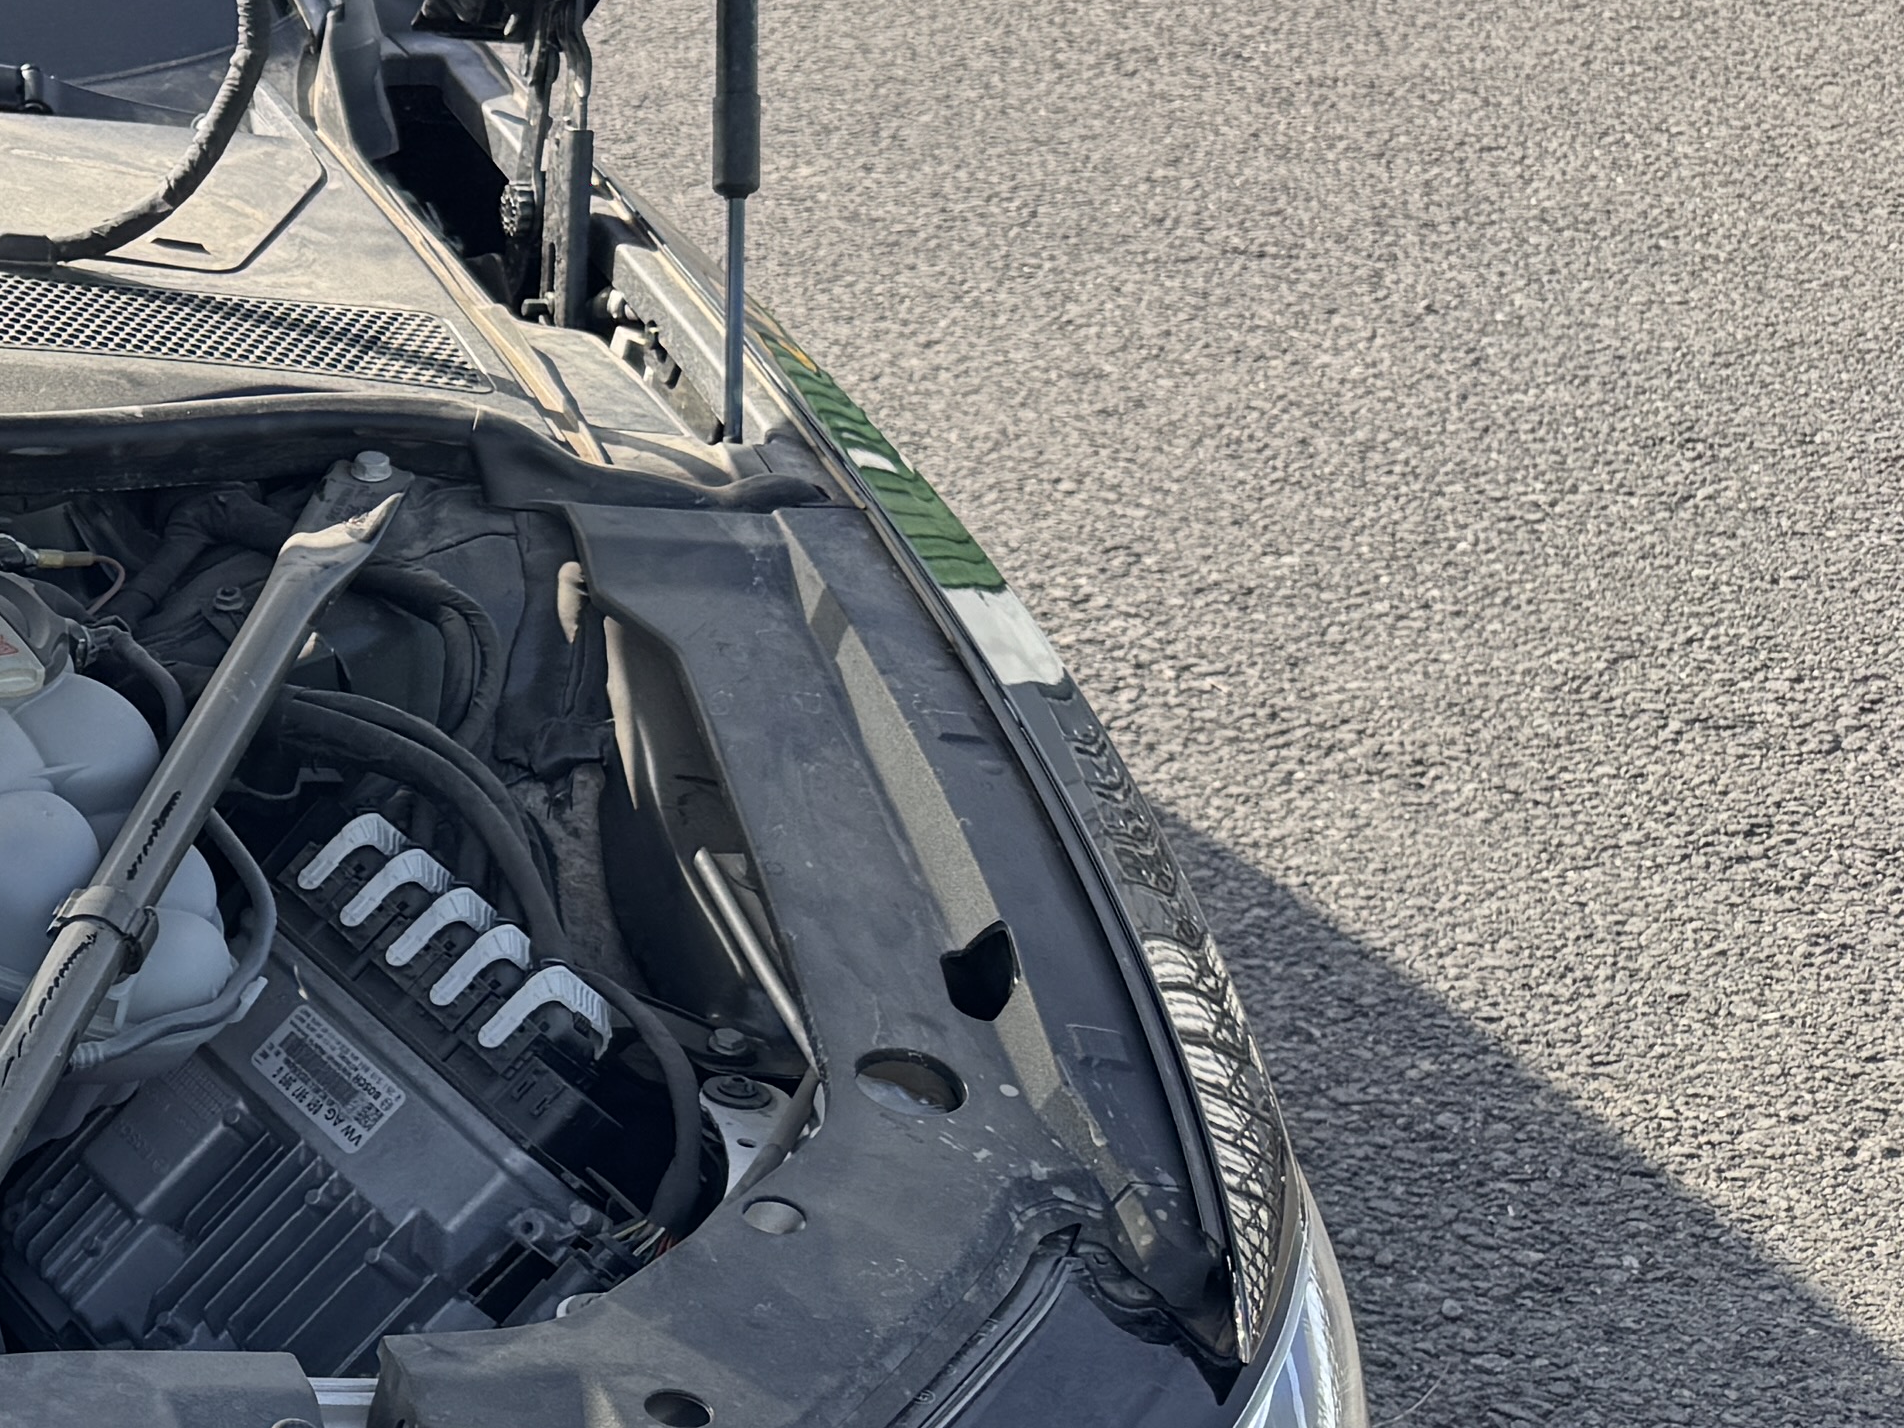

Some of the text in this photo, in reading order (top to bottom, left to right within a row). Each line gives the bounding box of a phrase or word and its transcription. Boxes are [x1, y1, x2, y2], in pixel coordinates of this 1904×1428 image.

[350, 1071, 383, 1102] BOSCH
[321, 1105, 346, 1129] AG
[339, 1122, 365, 1147] VW
